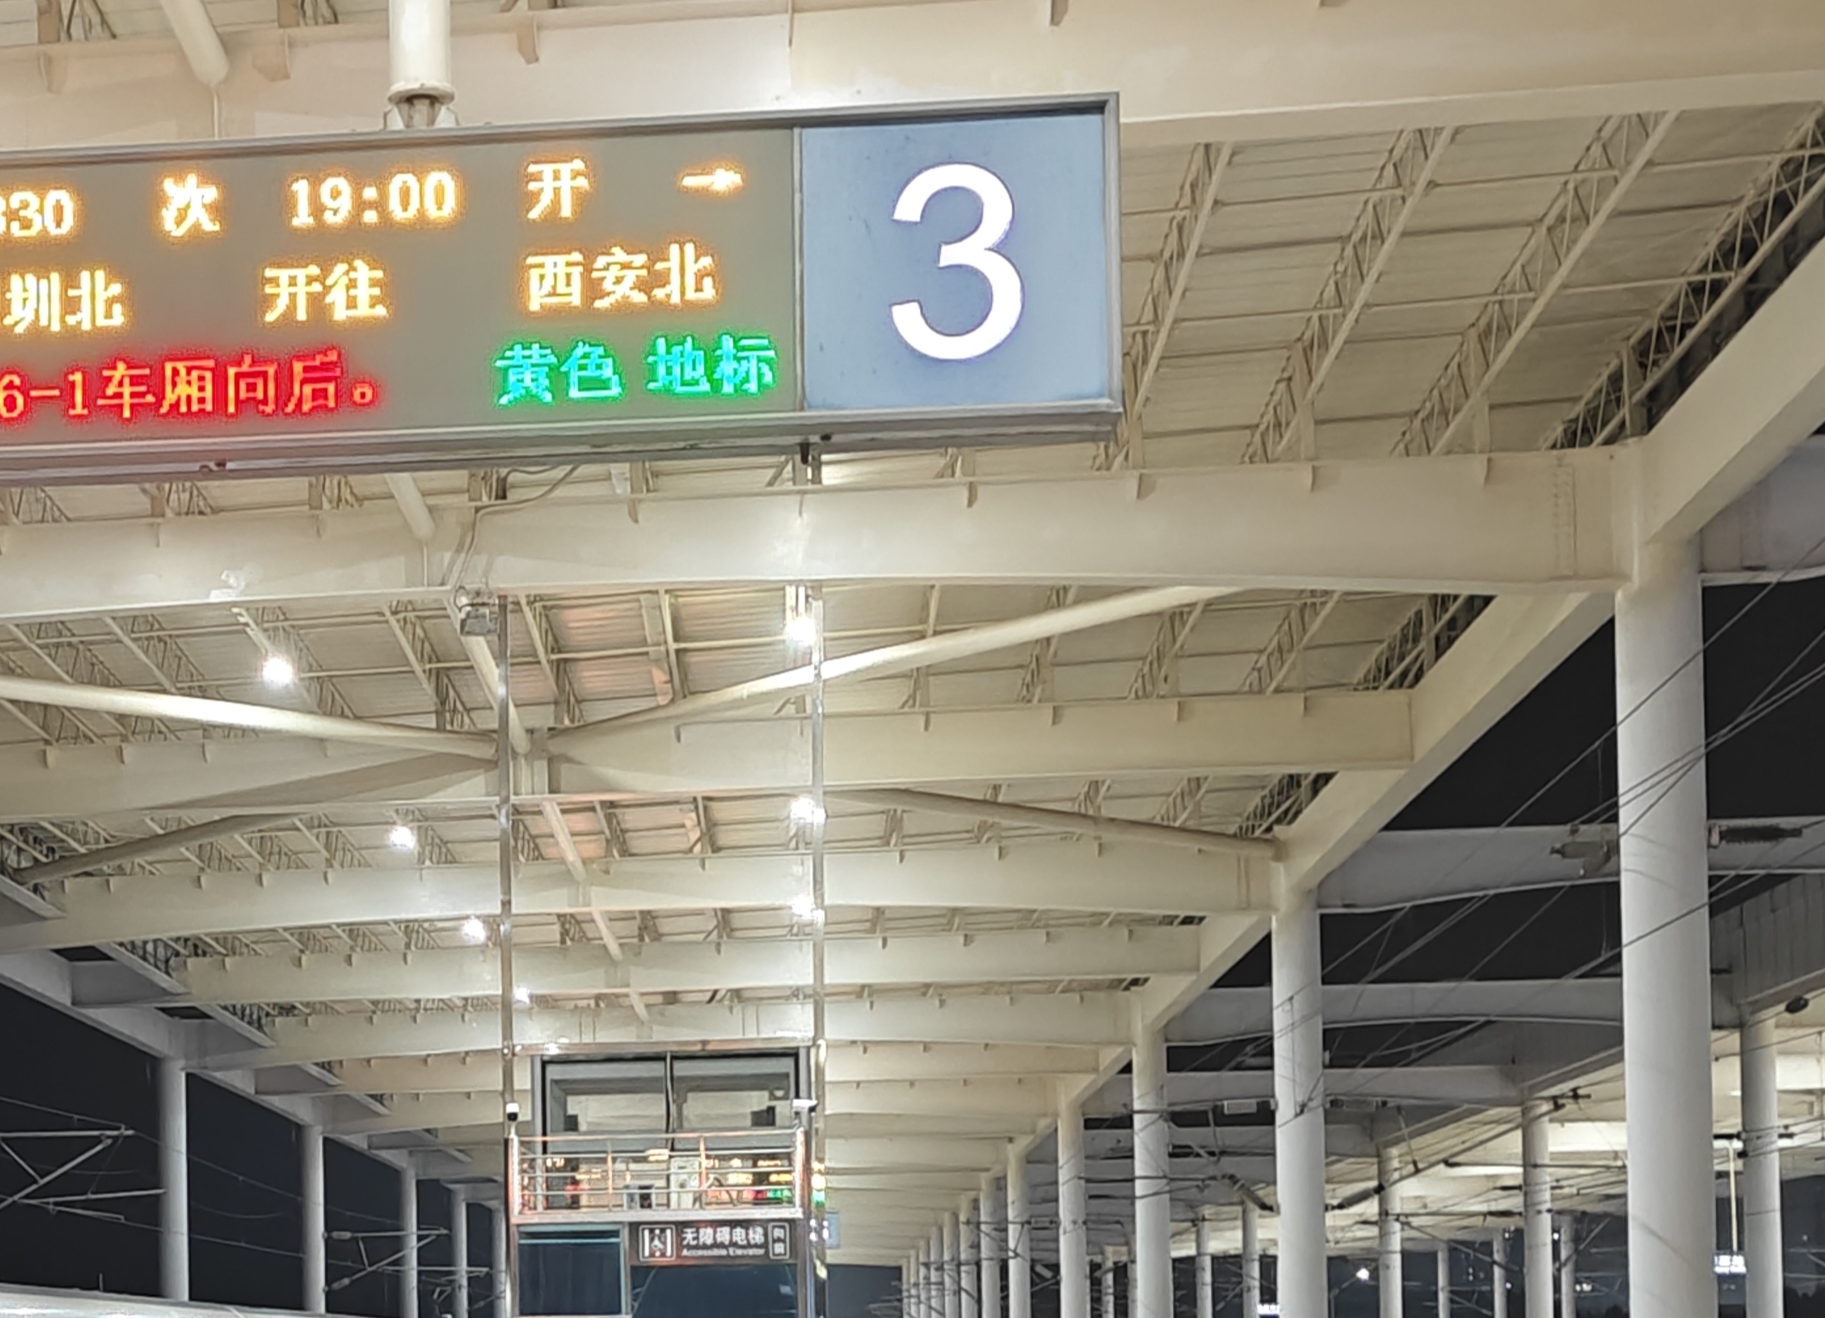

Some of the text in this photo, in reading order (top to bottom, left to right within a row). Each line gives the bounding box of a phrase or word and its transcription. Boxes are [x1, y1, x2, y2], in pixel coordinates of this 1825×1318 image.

[161, 171, 222, 238] 次
[289, 168, 459, 228] 19:00
[526, 156, 591, 220] 开
[263, 258, 389, 323] 开往
[525, 241, 718, 313] 西安北
[889, 161, 1024, 361] 3
[493, 331, 777, 408] 黄色 地标
[682, 1226, 765, 1247] 无障碍电梯
